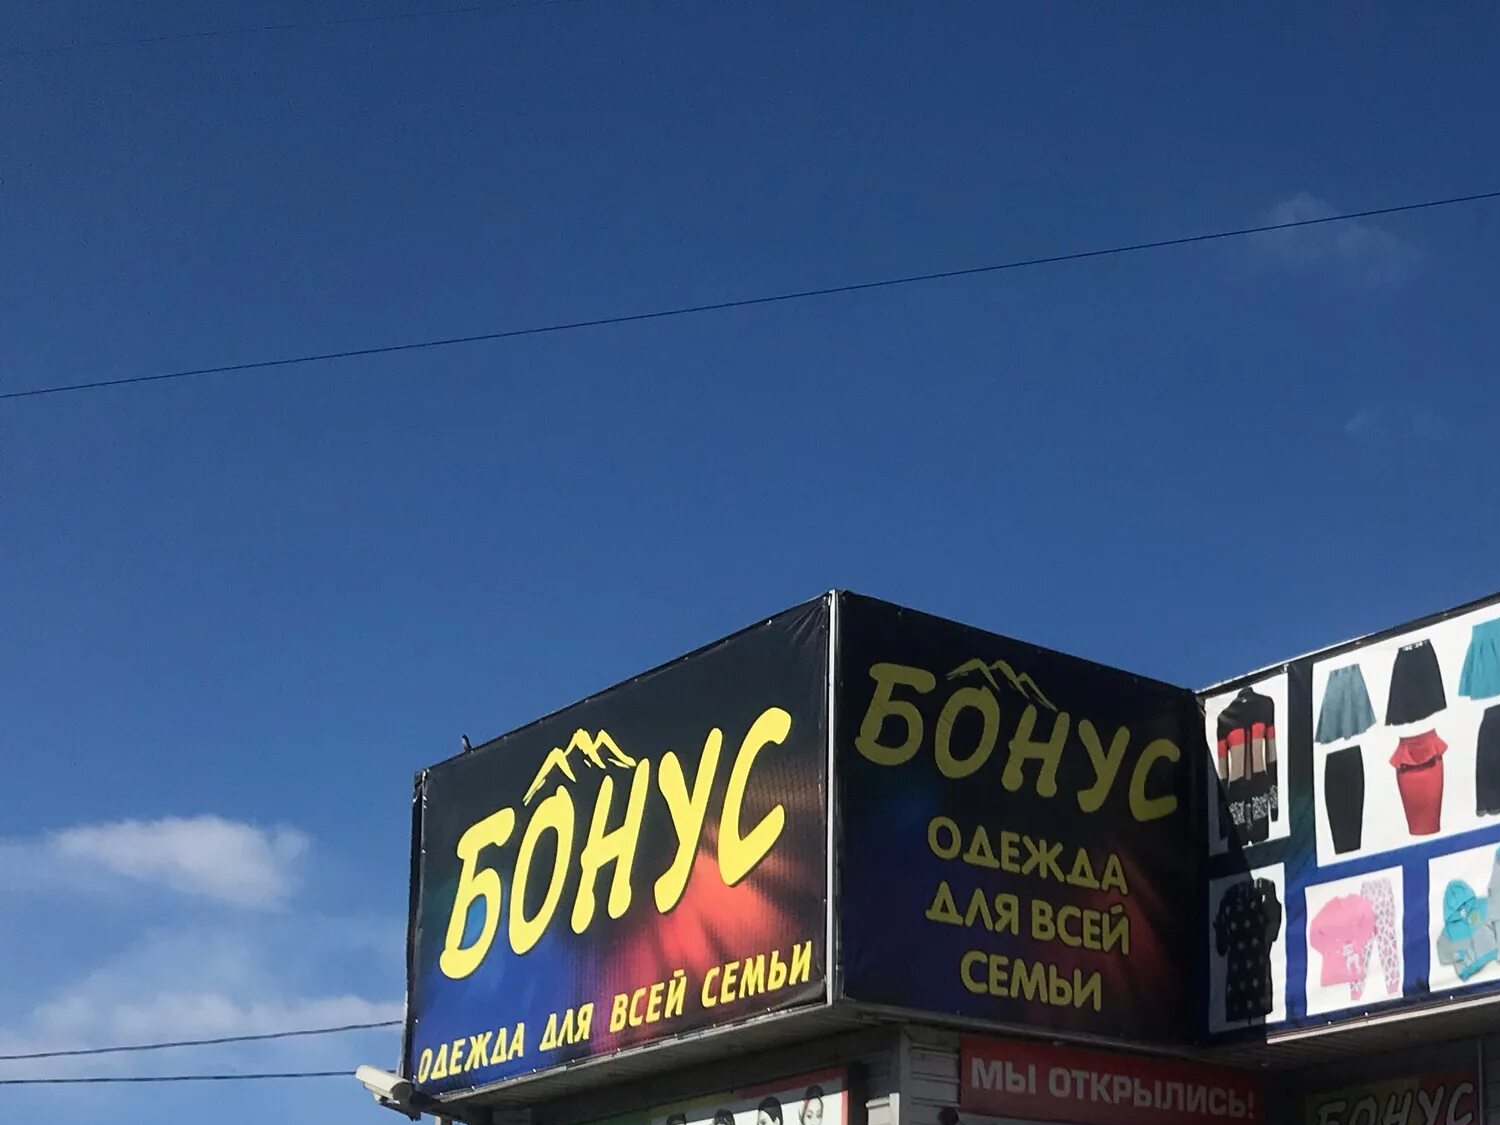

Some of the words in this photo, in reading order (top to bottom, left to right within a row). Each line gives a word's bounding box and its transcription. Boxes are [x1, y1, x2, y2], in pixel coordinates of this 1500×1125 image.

[854, 661, 1182, 822] БОНУС
[439, 707, 792, 979] БОНУС
[927, 815, 1129, 896] ОДЕЖДА
[925, 881, 1021, 935] ДЛЯ
[1032, 901, 1130, 955] ВСЕЙ
[418, 1027, 526, 1086] ОДЕЖДА
[540, 1001, 592, 1049] ДЛЯ
[610, 975, 686, 1033] ВСЕЙ
[701, 940, 813, 1009] СЕМЬИ
[959, 950, 1103, 1012] СЕМЬИ
[970, 1057, 1036, 1095] МЫ
[1049, 1066, 1255, 1120] ОТКРЫЛИСЬ!
